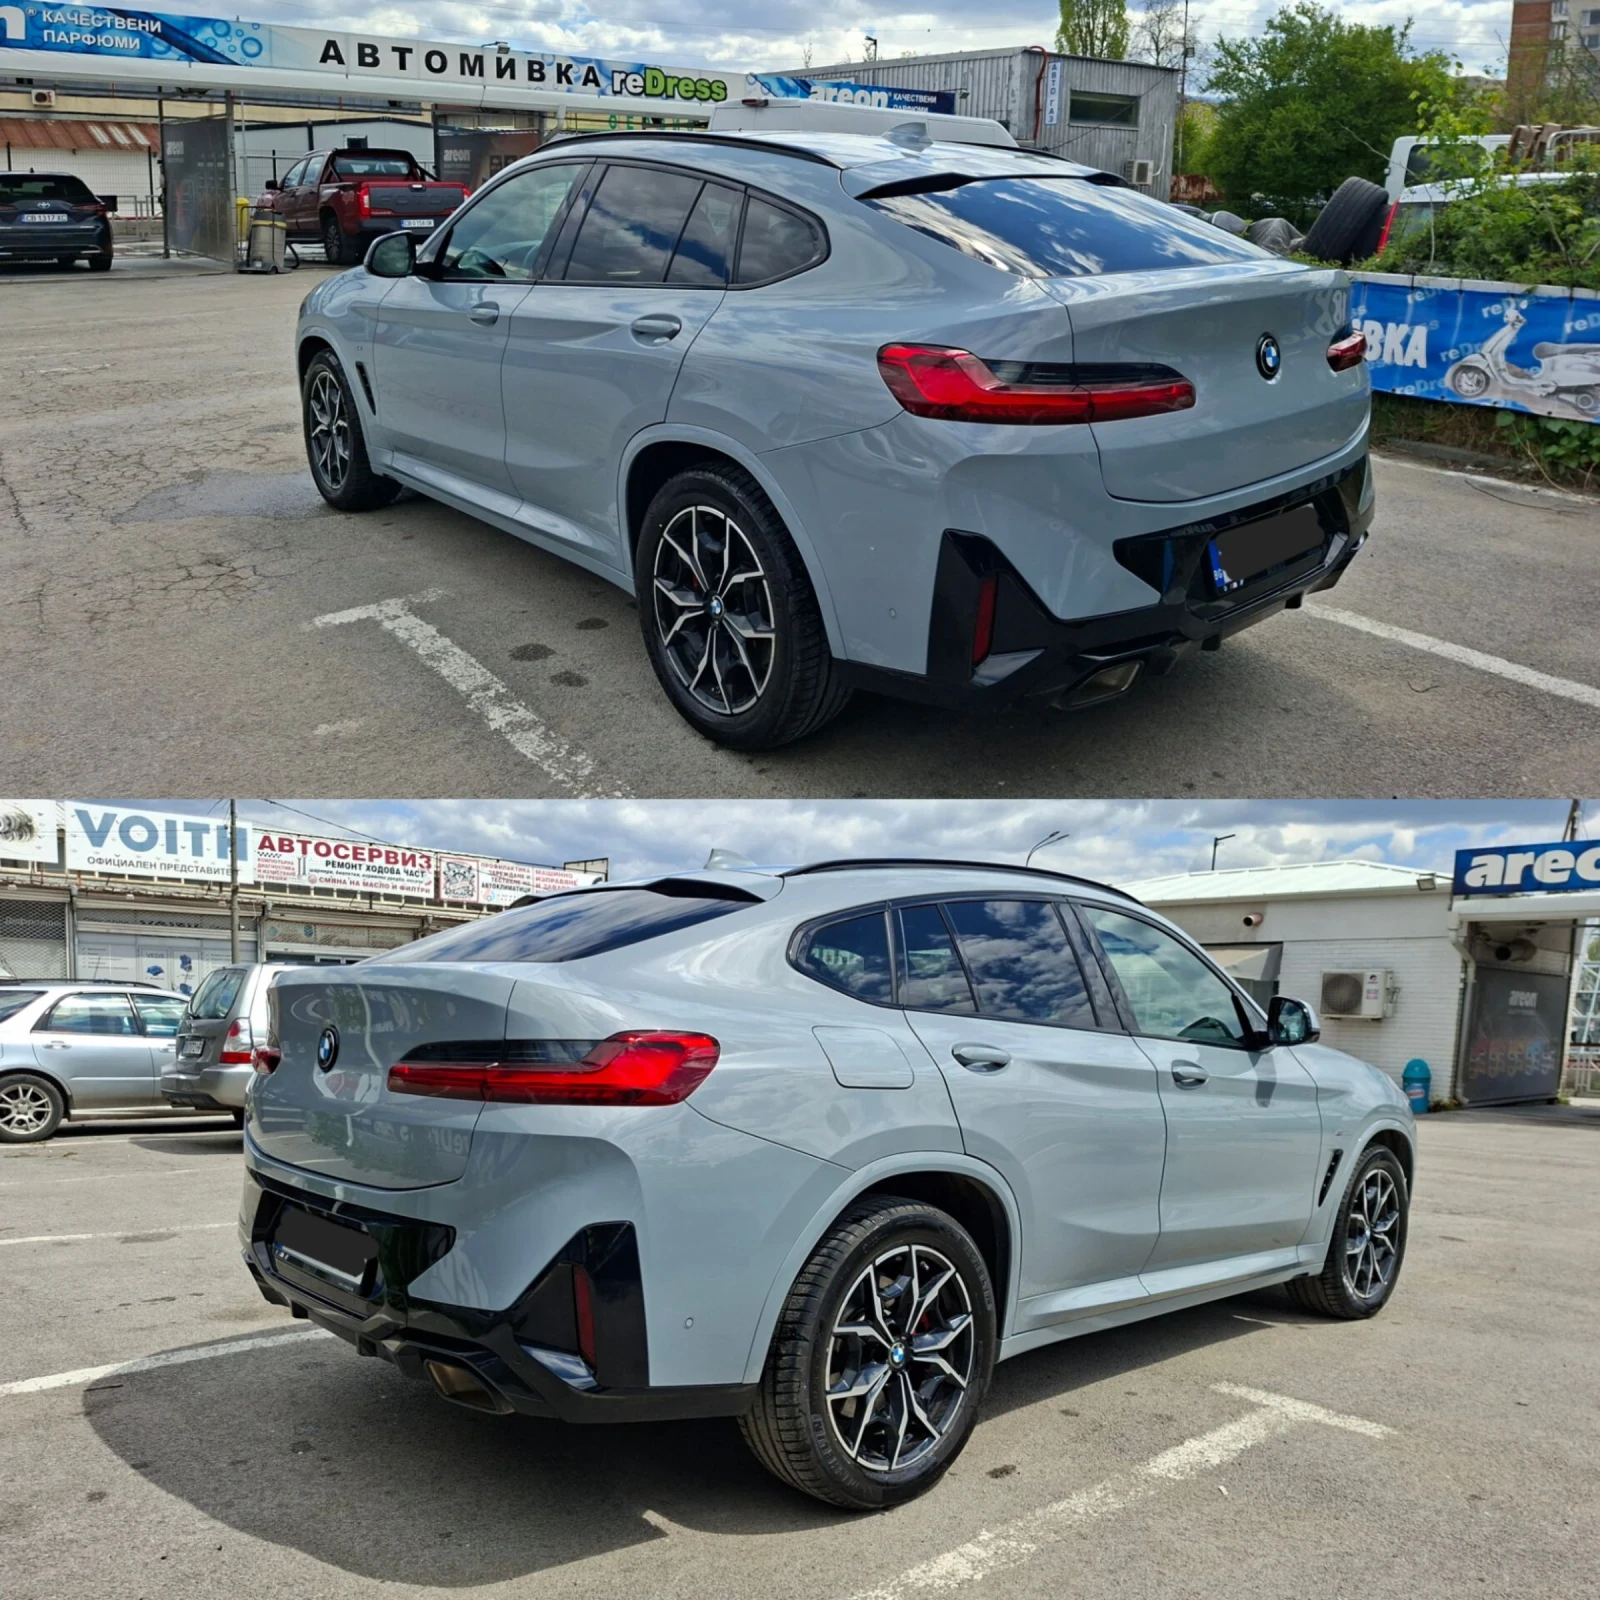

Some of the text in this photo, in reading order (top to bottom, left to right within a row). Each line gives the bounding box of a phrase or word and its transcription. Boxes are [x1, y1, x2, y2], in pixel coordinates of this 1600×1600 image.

[42, 10, 162, 33] КАЧЕСТВЕНИ
[43, 30, 141, 50] ПАРФЮМИ
[319, 39, 600, 88] АВТОМИВКА
[612, 68, 728, 102] reDress
[893, 93, 937, 104] КАЧЕСТВЕНИ
[74, 808, 248, 862] VOITH
[258, 835, 432, 869] АВТОСЕРВИЗ
[87, 855, 238, 878] ОФИЦИАЛЕН ПРЕДСТАВИТЕ
[325, 859, 426, 879] РЕМОНТ ХОДОВА ЧАСТ
[319, 876, 347, 886] СМЯНА
[349, 879, 361, 887] НА
[362, 881, 390, 890] МАСЛО
